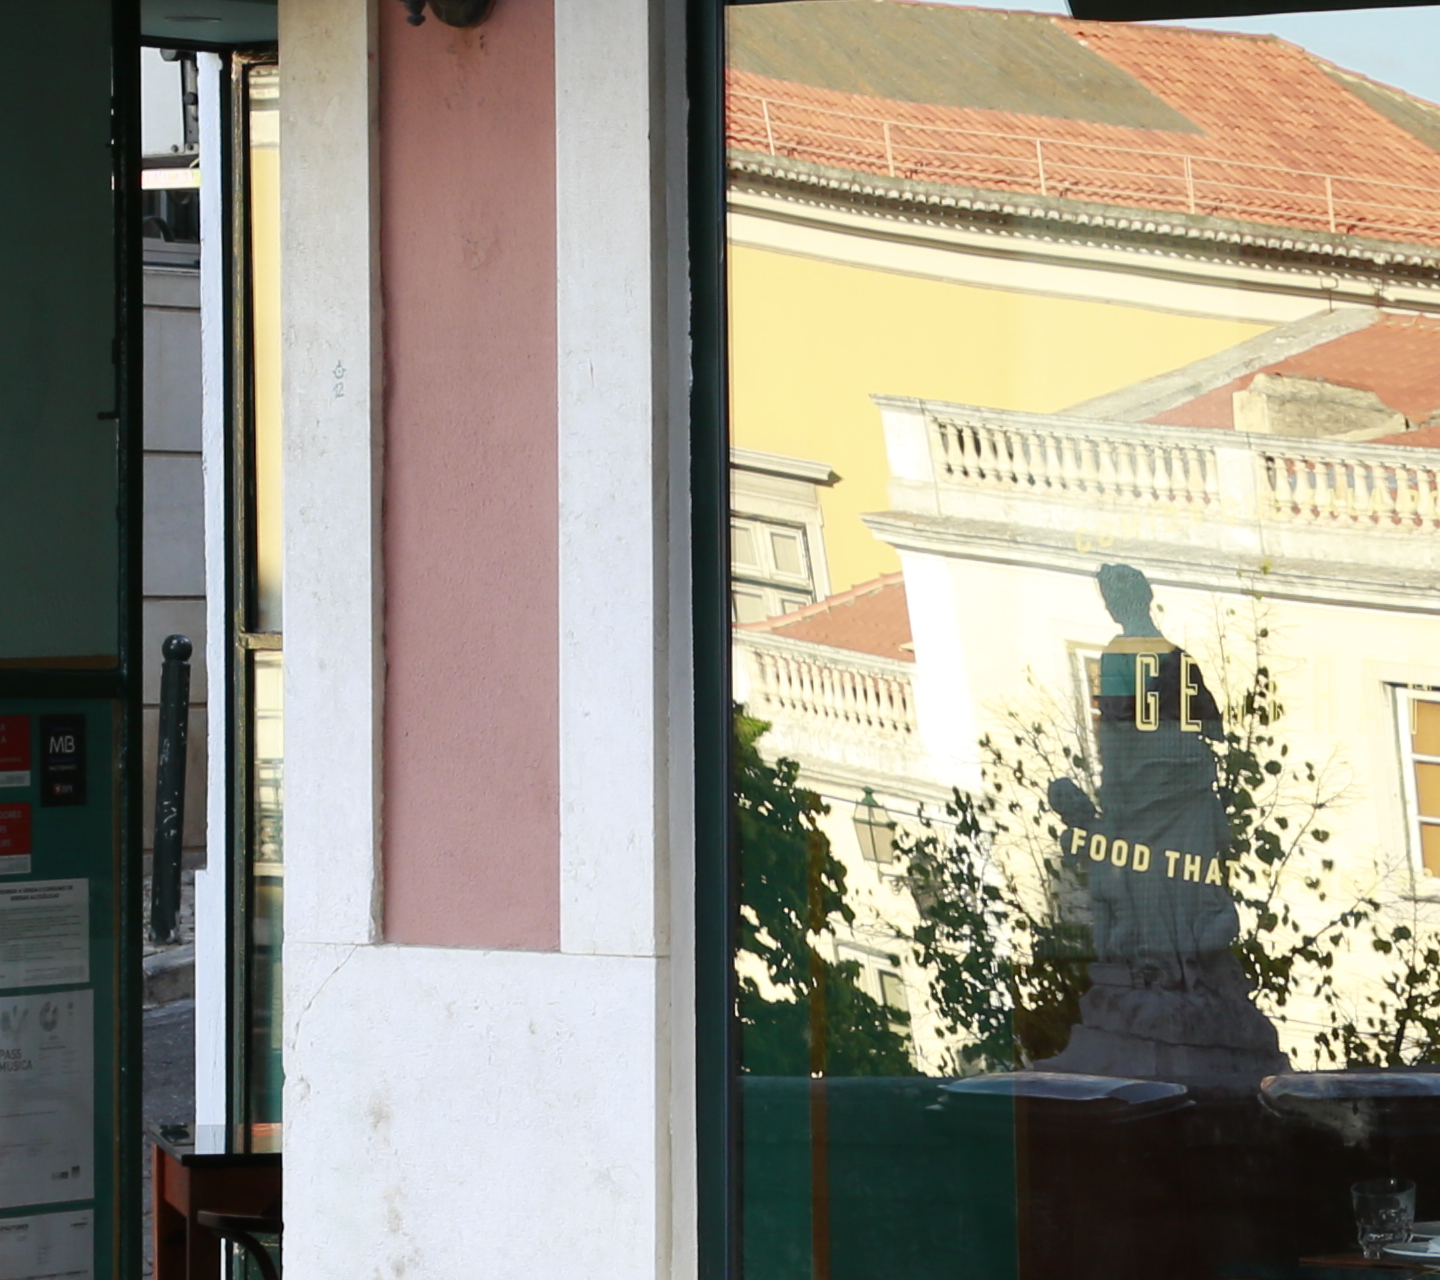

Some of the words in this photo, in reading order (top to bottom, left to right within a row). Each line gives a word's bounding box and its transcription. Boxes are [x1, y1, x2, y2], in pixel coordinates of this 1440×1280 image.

[49, 735, 76, 754] MB
[1070, 827, 1150, 873] FOOD
[1164, 849, 1242, 890] THAT
